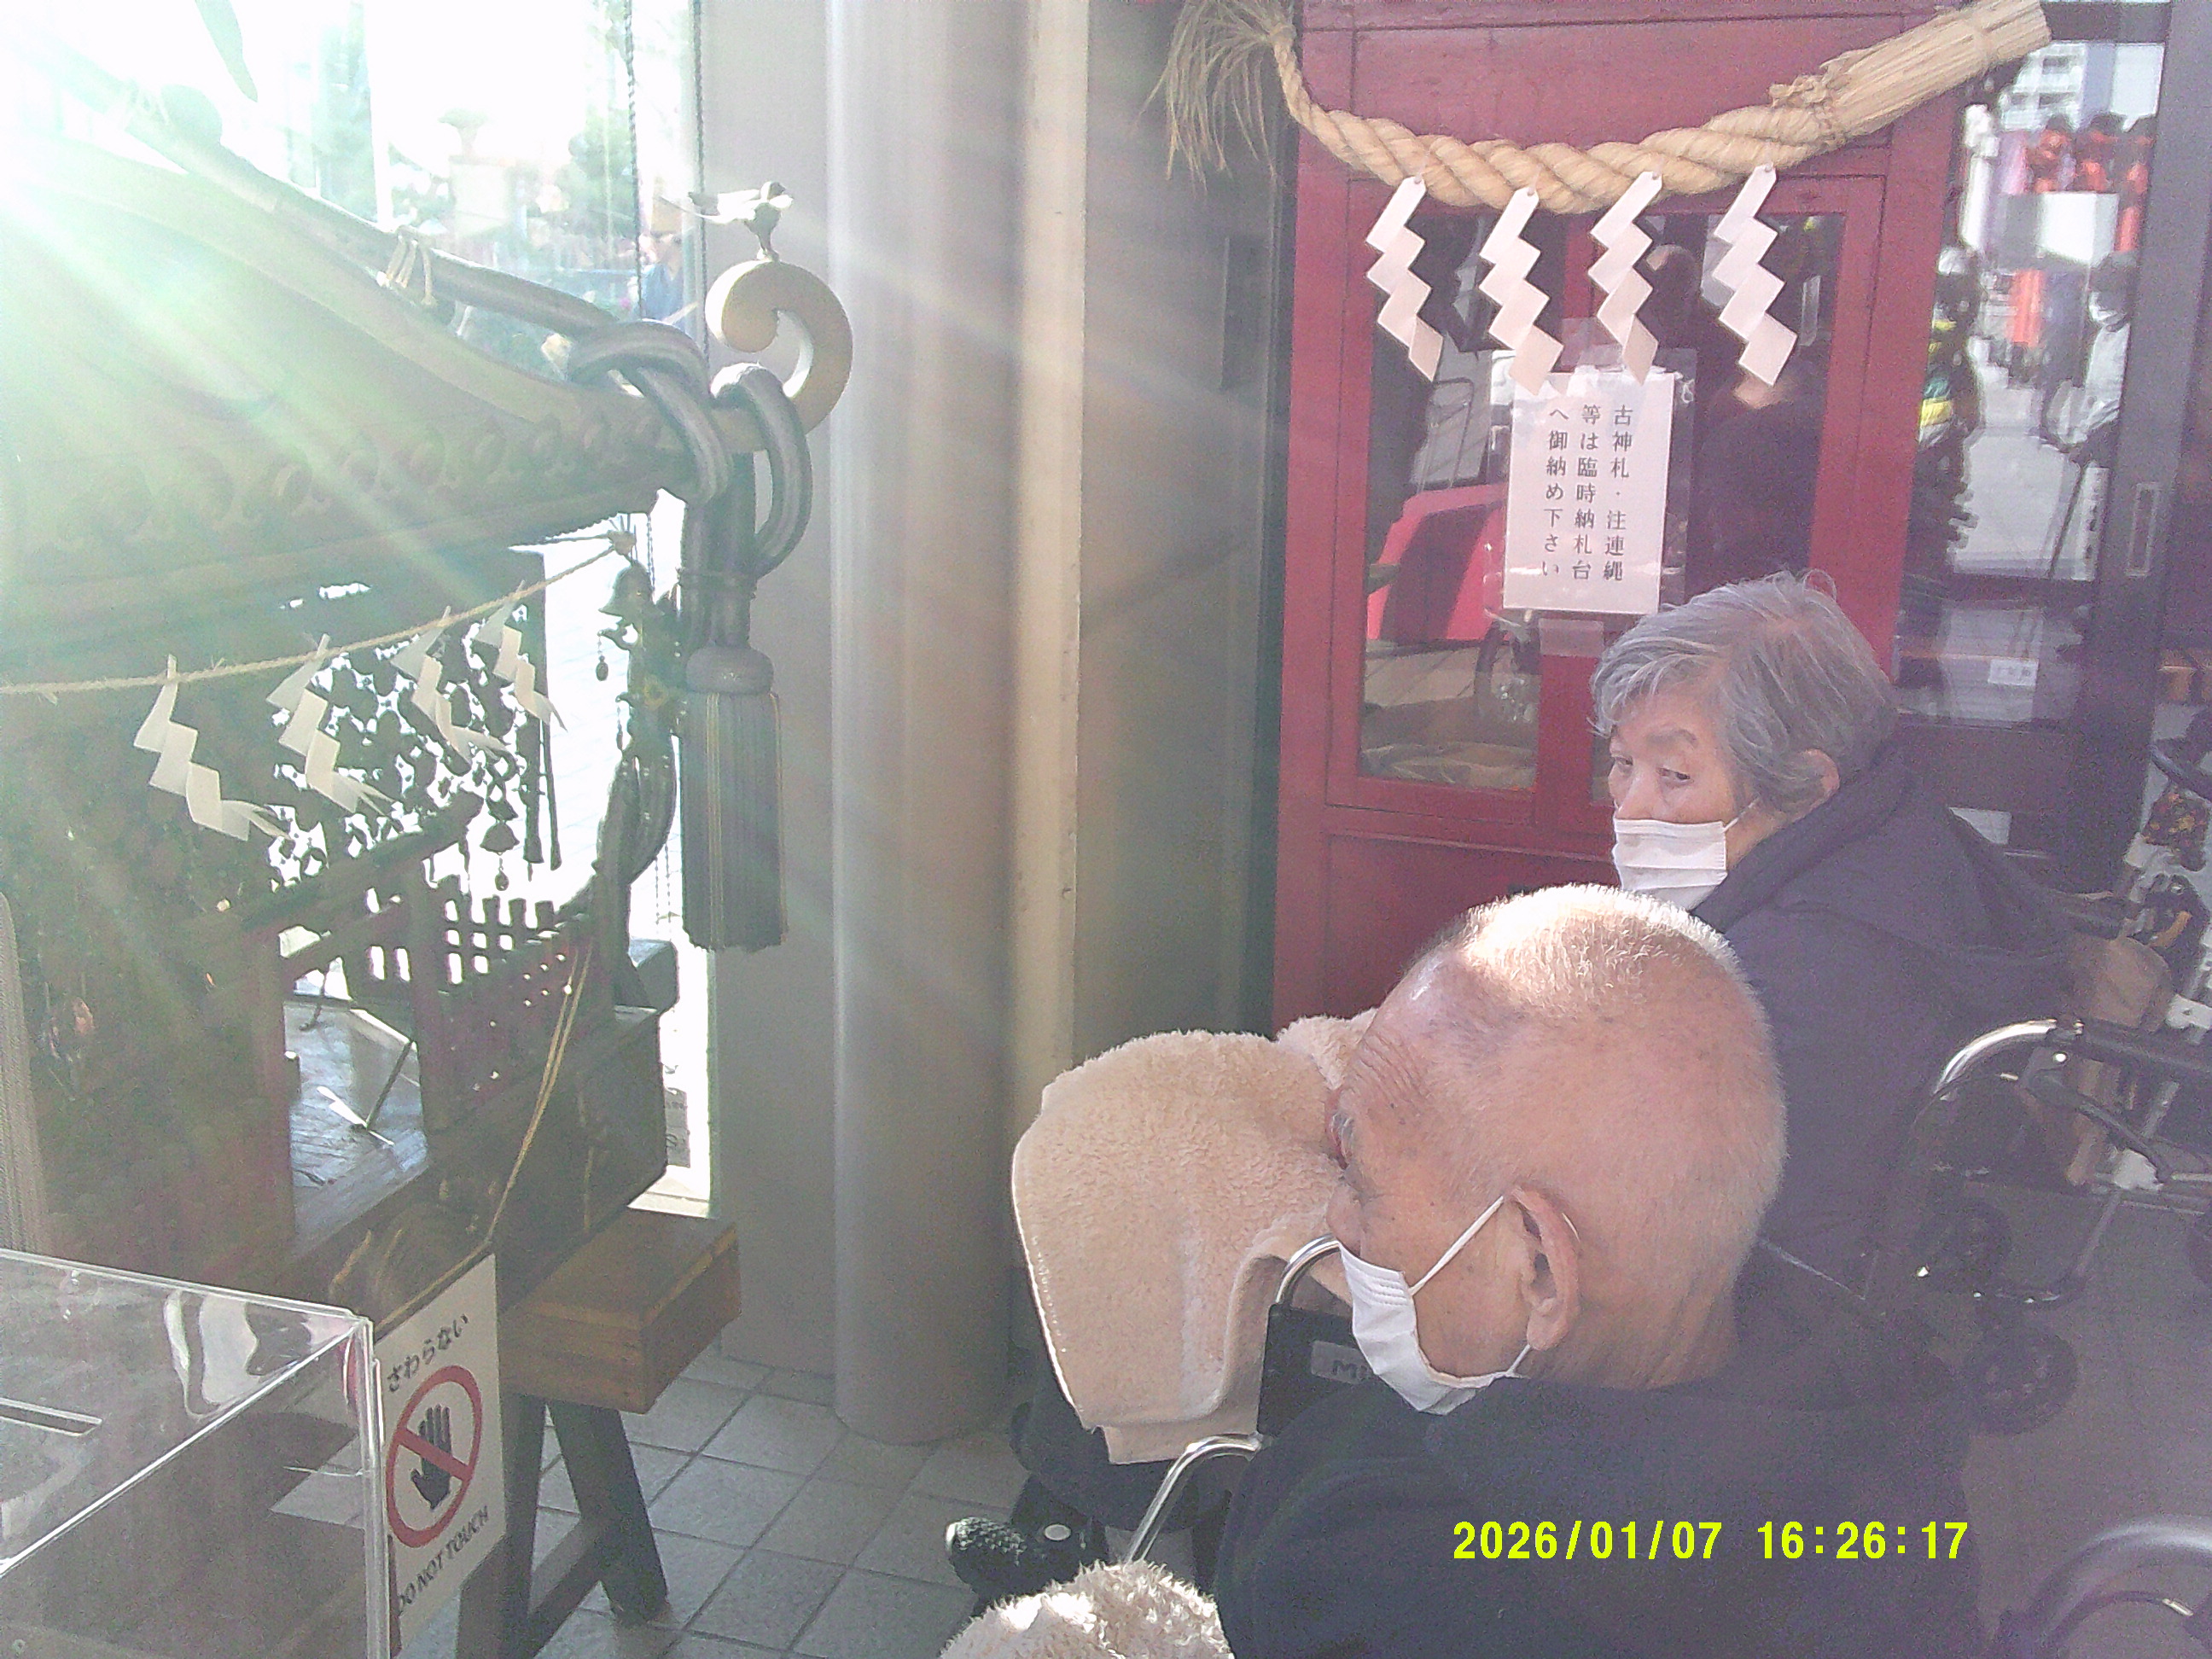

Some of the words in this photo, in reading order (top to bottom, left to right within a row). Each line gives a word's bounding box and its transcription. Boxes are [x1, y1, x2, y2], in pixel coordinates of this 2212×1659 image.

[1542, 408, 1569, 577] へ御納め下さい
[1572, 404, 1601, 580] 等は臨時納札台
[387, 1313, 469, 1392] さわらない
[416, 1549, 443, 1592] NOT
[445, 1505, 489, 1560] TOUCH
